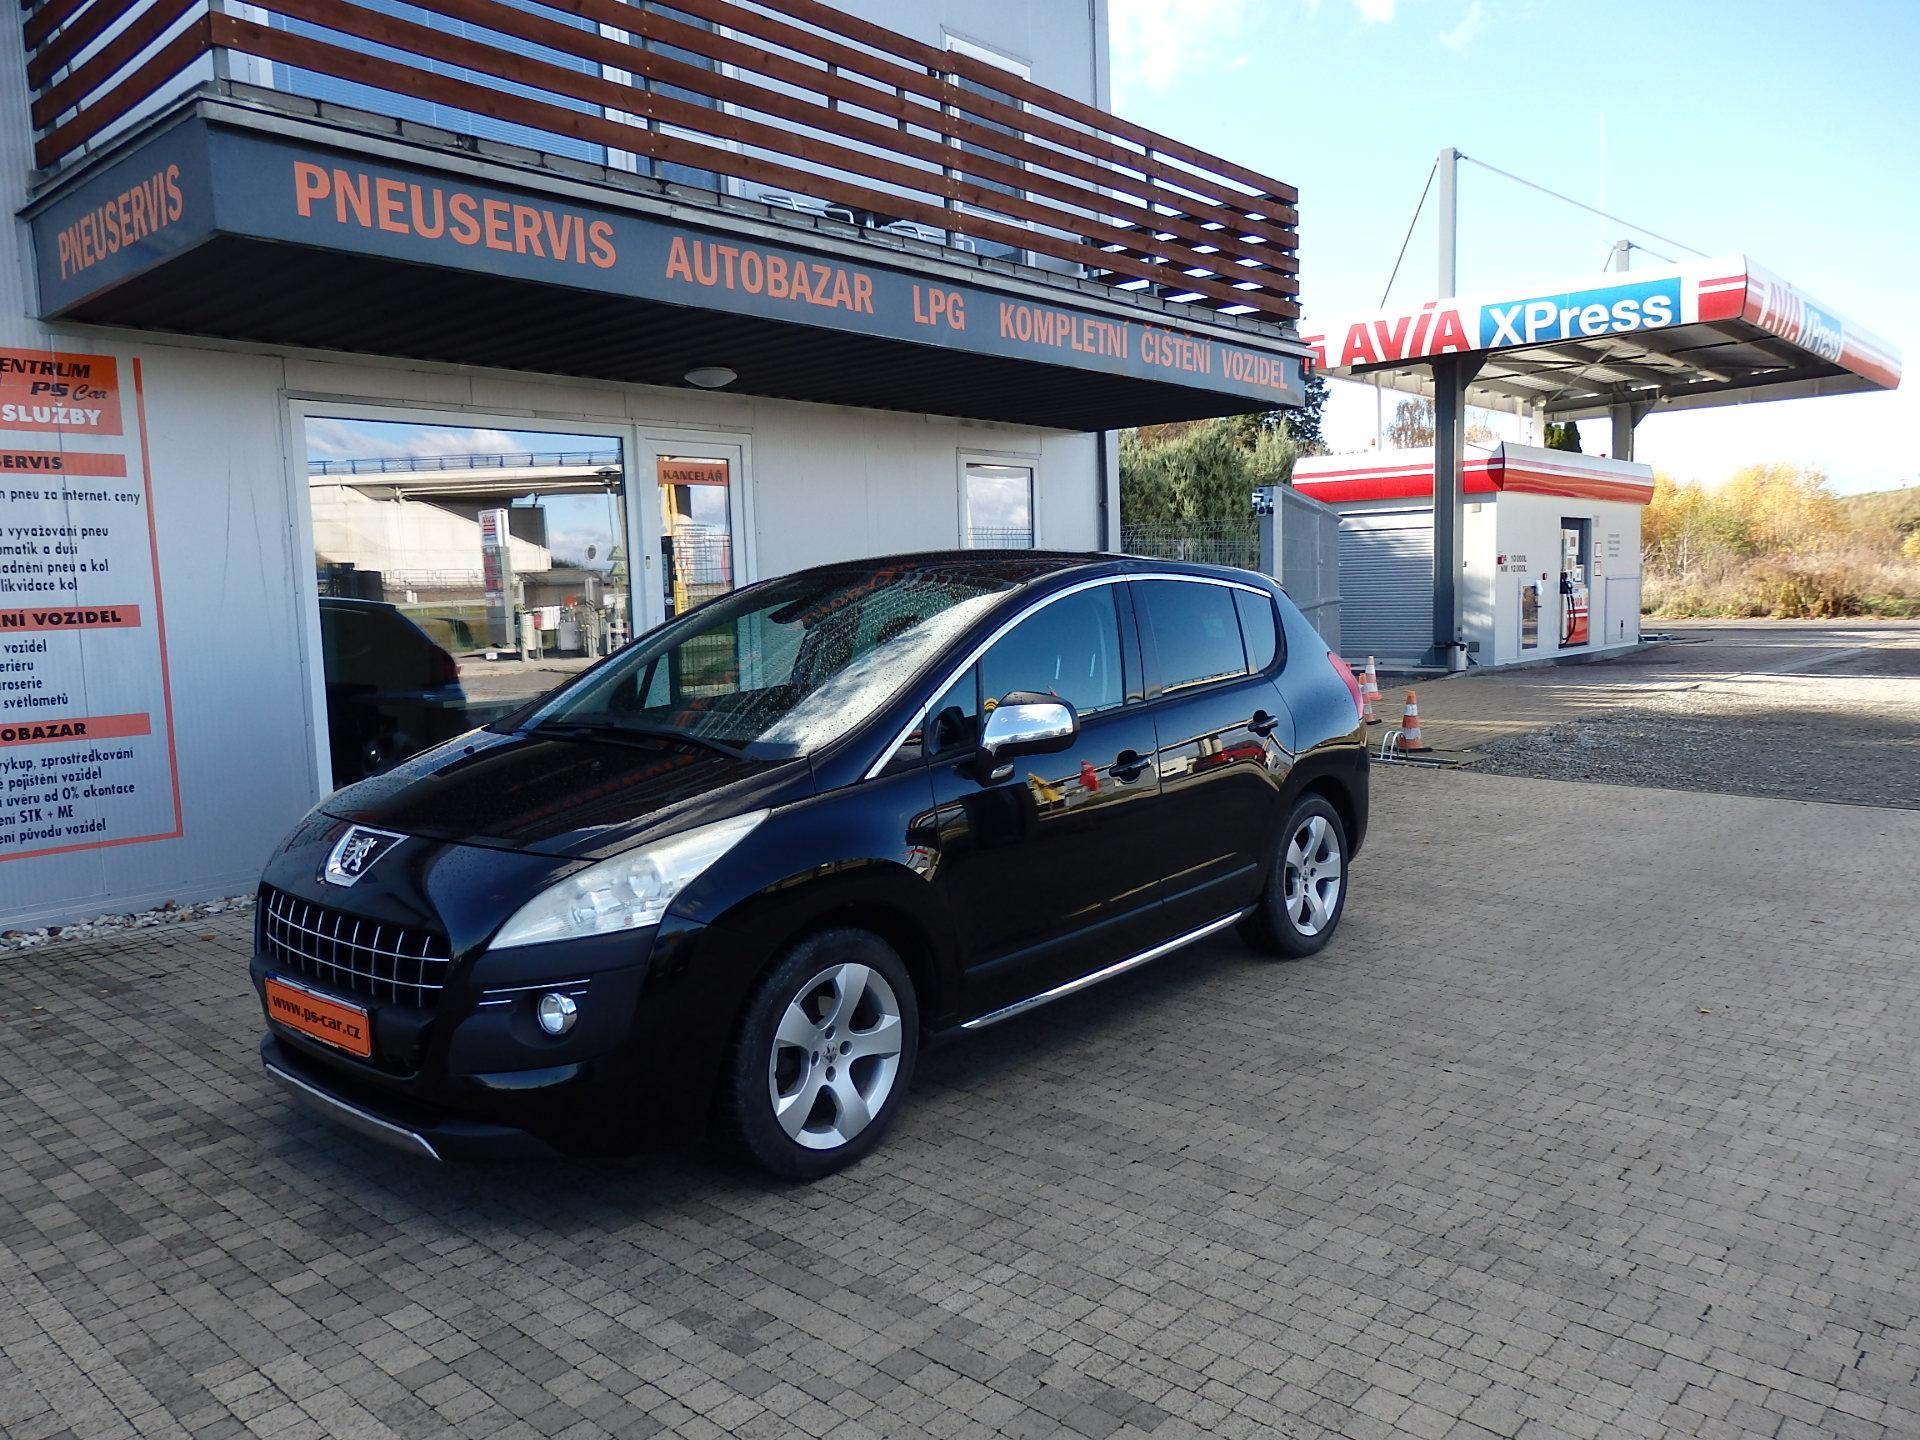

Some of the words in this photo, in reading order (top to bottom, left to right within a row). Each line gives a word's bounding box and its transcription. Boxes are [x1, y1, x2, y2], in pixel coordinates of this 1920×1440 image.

[57, 163, 183, 280] PNEUSERVIS
[294, 160, 617, 269] PNEUSERVIS
[664, 235, 874, 314] AUTOBAZAR
[912, 284, 965, 330] LPG
[1000, 301, 1129, 360] KOMPLETNÍ
[1140, 322, 1212, 375] ČIŠTĚNÍ
[1219, 348, 1289, 390] VOZIDEL
[1488, 294, 1673, 348] XPress
[30, 381, 70, 397] PS
[1, 402, 102, 427] SLUŽBY
[0, 454, 63, 470] ERVIS
[663, 468, 723, 483] KANCELÁŘ
[11, 489, 39, 503] pneu
[44, 489, 58, 501] za
[62, 487, 111, 502] internet.
[115, 491, 140, 506] ceny
[8, 525, 77, 541] vyvažování
[81, 528, 109, 540] pneu
[43, 545, 50, 556] a
[0, 560, 43, 574] adnění
[47, 563, 76, 577] pneu
[80, 562, 87, 573] a
[91, 559, 109, 573] kol
[1, 578, 55, 593] likvidace
[60, 578, 78, 592] kol
[0, 608, 25, 628] NÍ
[33, 610, 122, 628] VOZIDEL
[4, 638, 47, 654] vozidel
[4, 694, 69, 710] světlometů
[41, 746, 134, 770] zprostředkování
[9, 774, 58, 792] pojištění
[62, 765, 102, 783] vozidel
[7, 792, 40, 808] úvěru
[44, 788, 58, 803] od
[62, 786, 79, 801] 0%
[83, 782, 136, 799] akontace
[20, 808, 42, 824] STK
[58, 804, 74, 820] ME
[19, 824, 61, 845] původu
[66, 817, 107, 837] vozidel
[272, 995, 362, 1040] www.ps-car.cz
